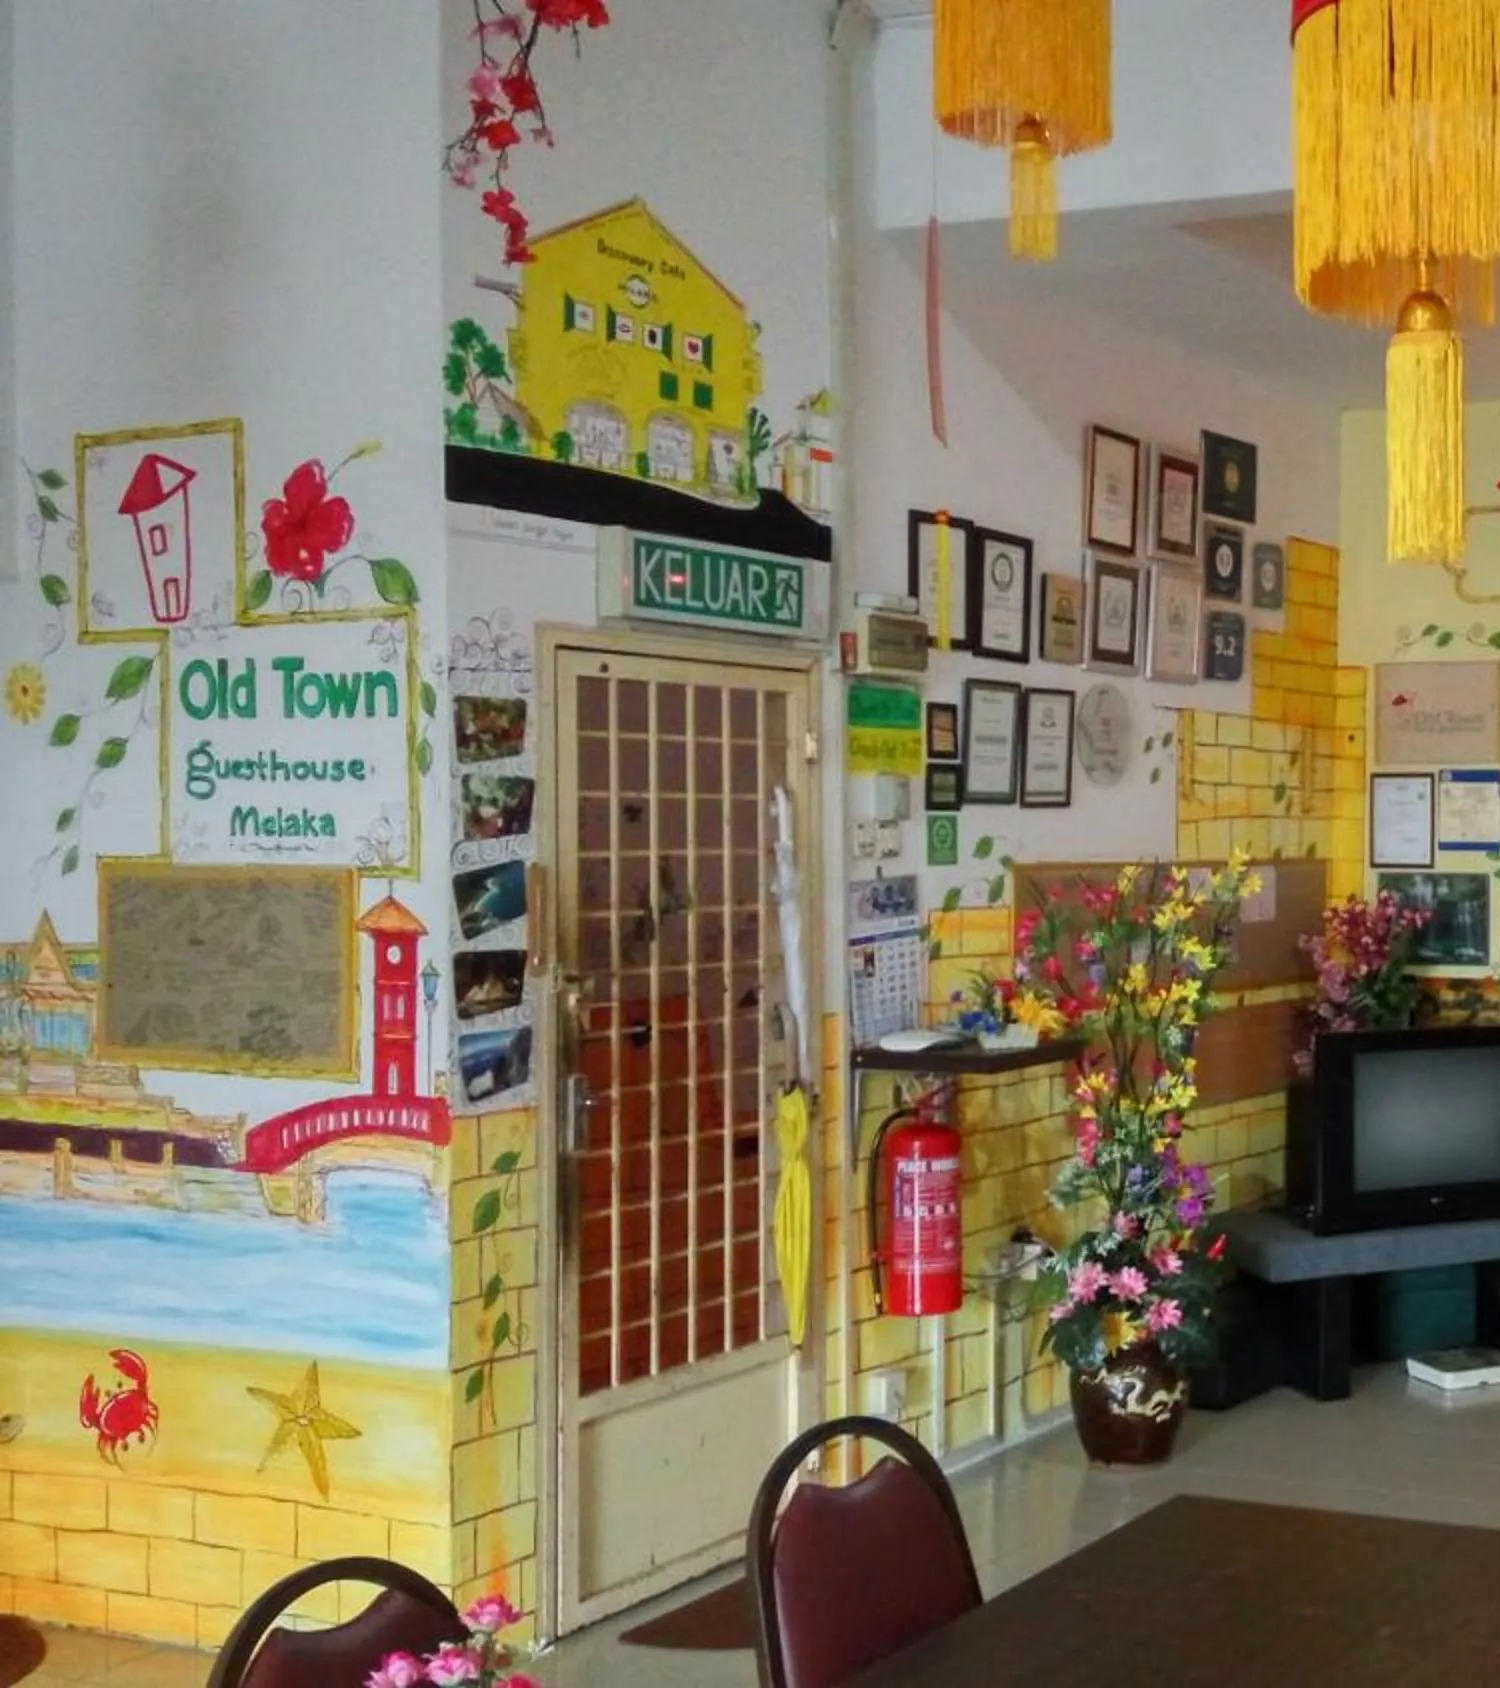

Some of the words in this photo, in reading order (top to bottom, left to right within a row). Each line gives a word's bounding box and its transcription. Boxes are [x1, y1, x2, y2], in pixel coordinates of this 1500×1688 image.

[639, 546, 768, 618] KELUAR
[1214, 634, 1237, 657] 9.2
[178, 656, 257, 720] Old
[272, 656, 399, 718] Town
[186, 740, 366, 799] guesthouse
[229, 805, 337, 838] Melaka
